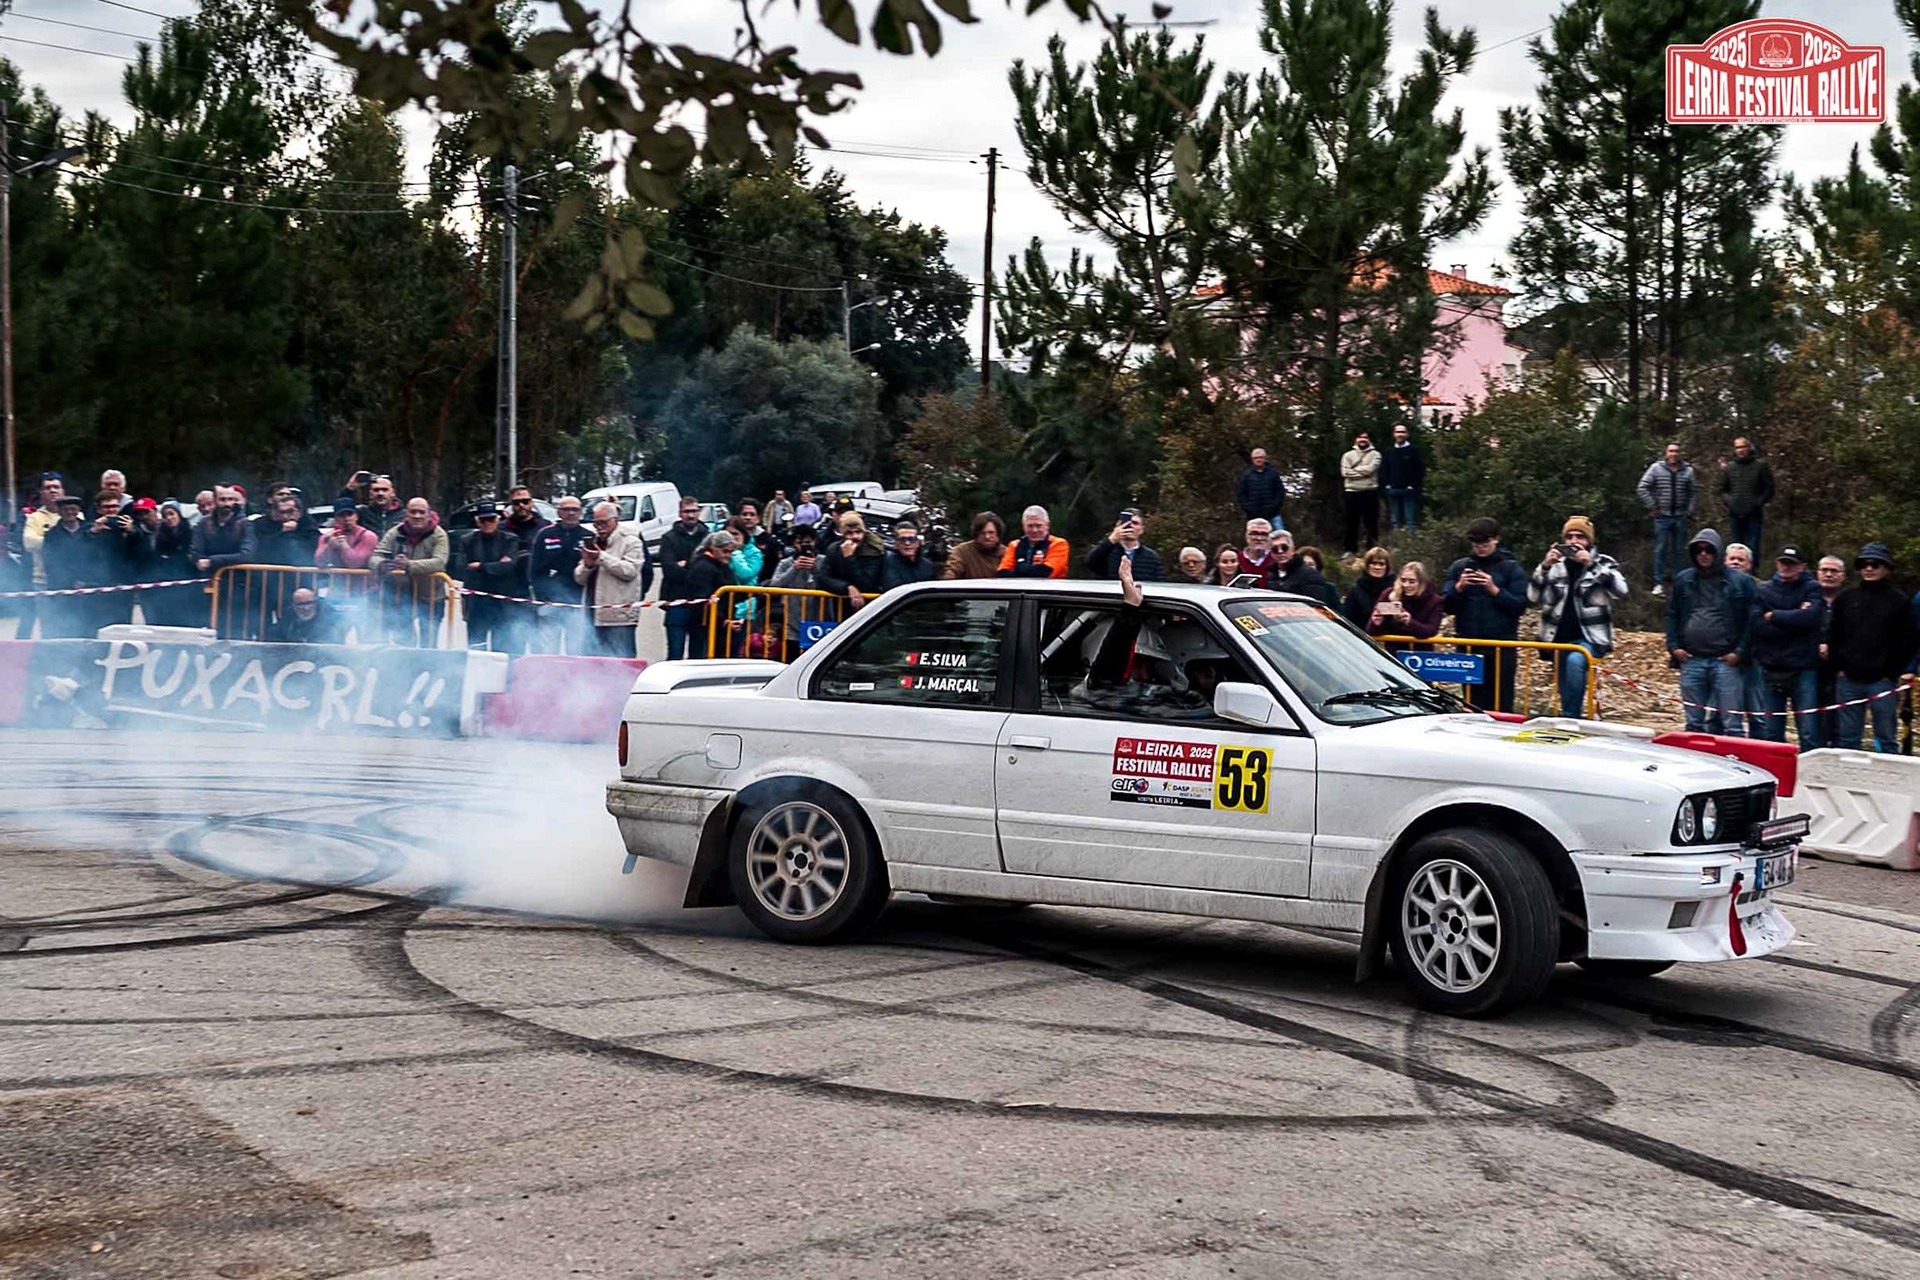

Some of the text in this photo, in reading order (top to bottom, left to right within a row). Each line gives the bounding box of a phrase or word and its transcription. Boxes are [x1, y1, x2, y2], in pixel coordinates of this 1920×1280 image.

[1136, 742, 1213, 759] LEIRIA 2025
[1116, 757, 1212, 778] FESTIVAL RALLYE
[1112, 778, 1136, 792] elf
[1218, 748, 1268, 811] 53
